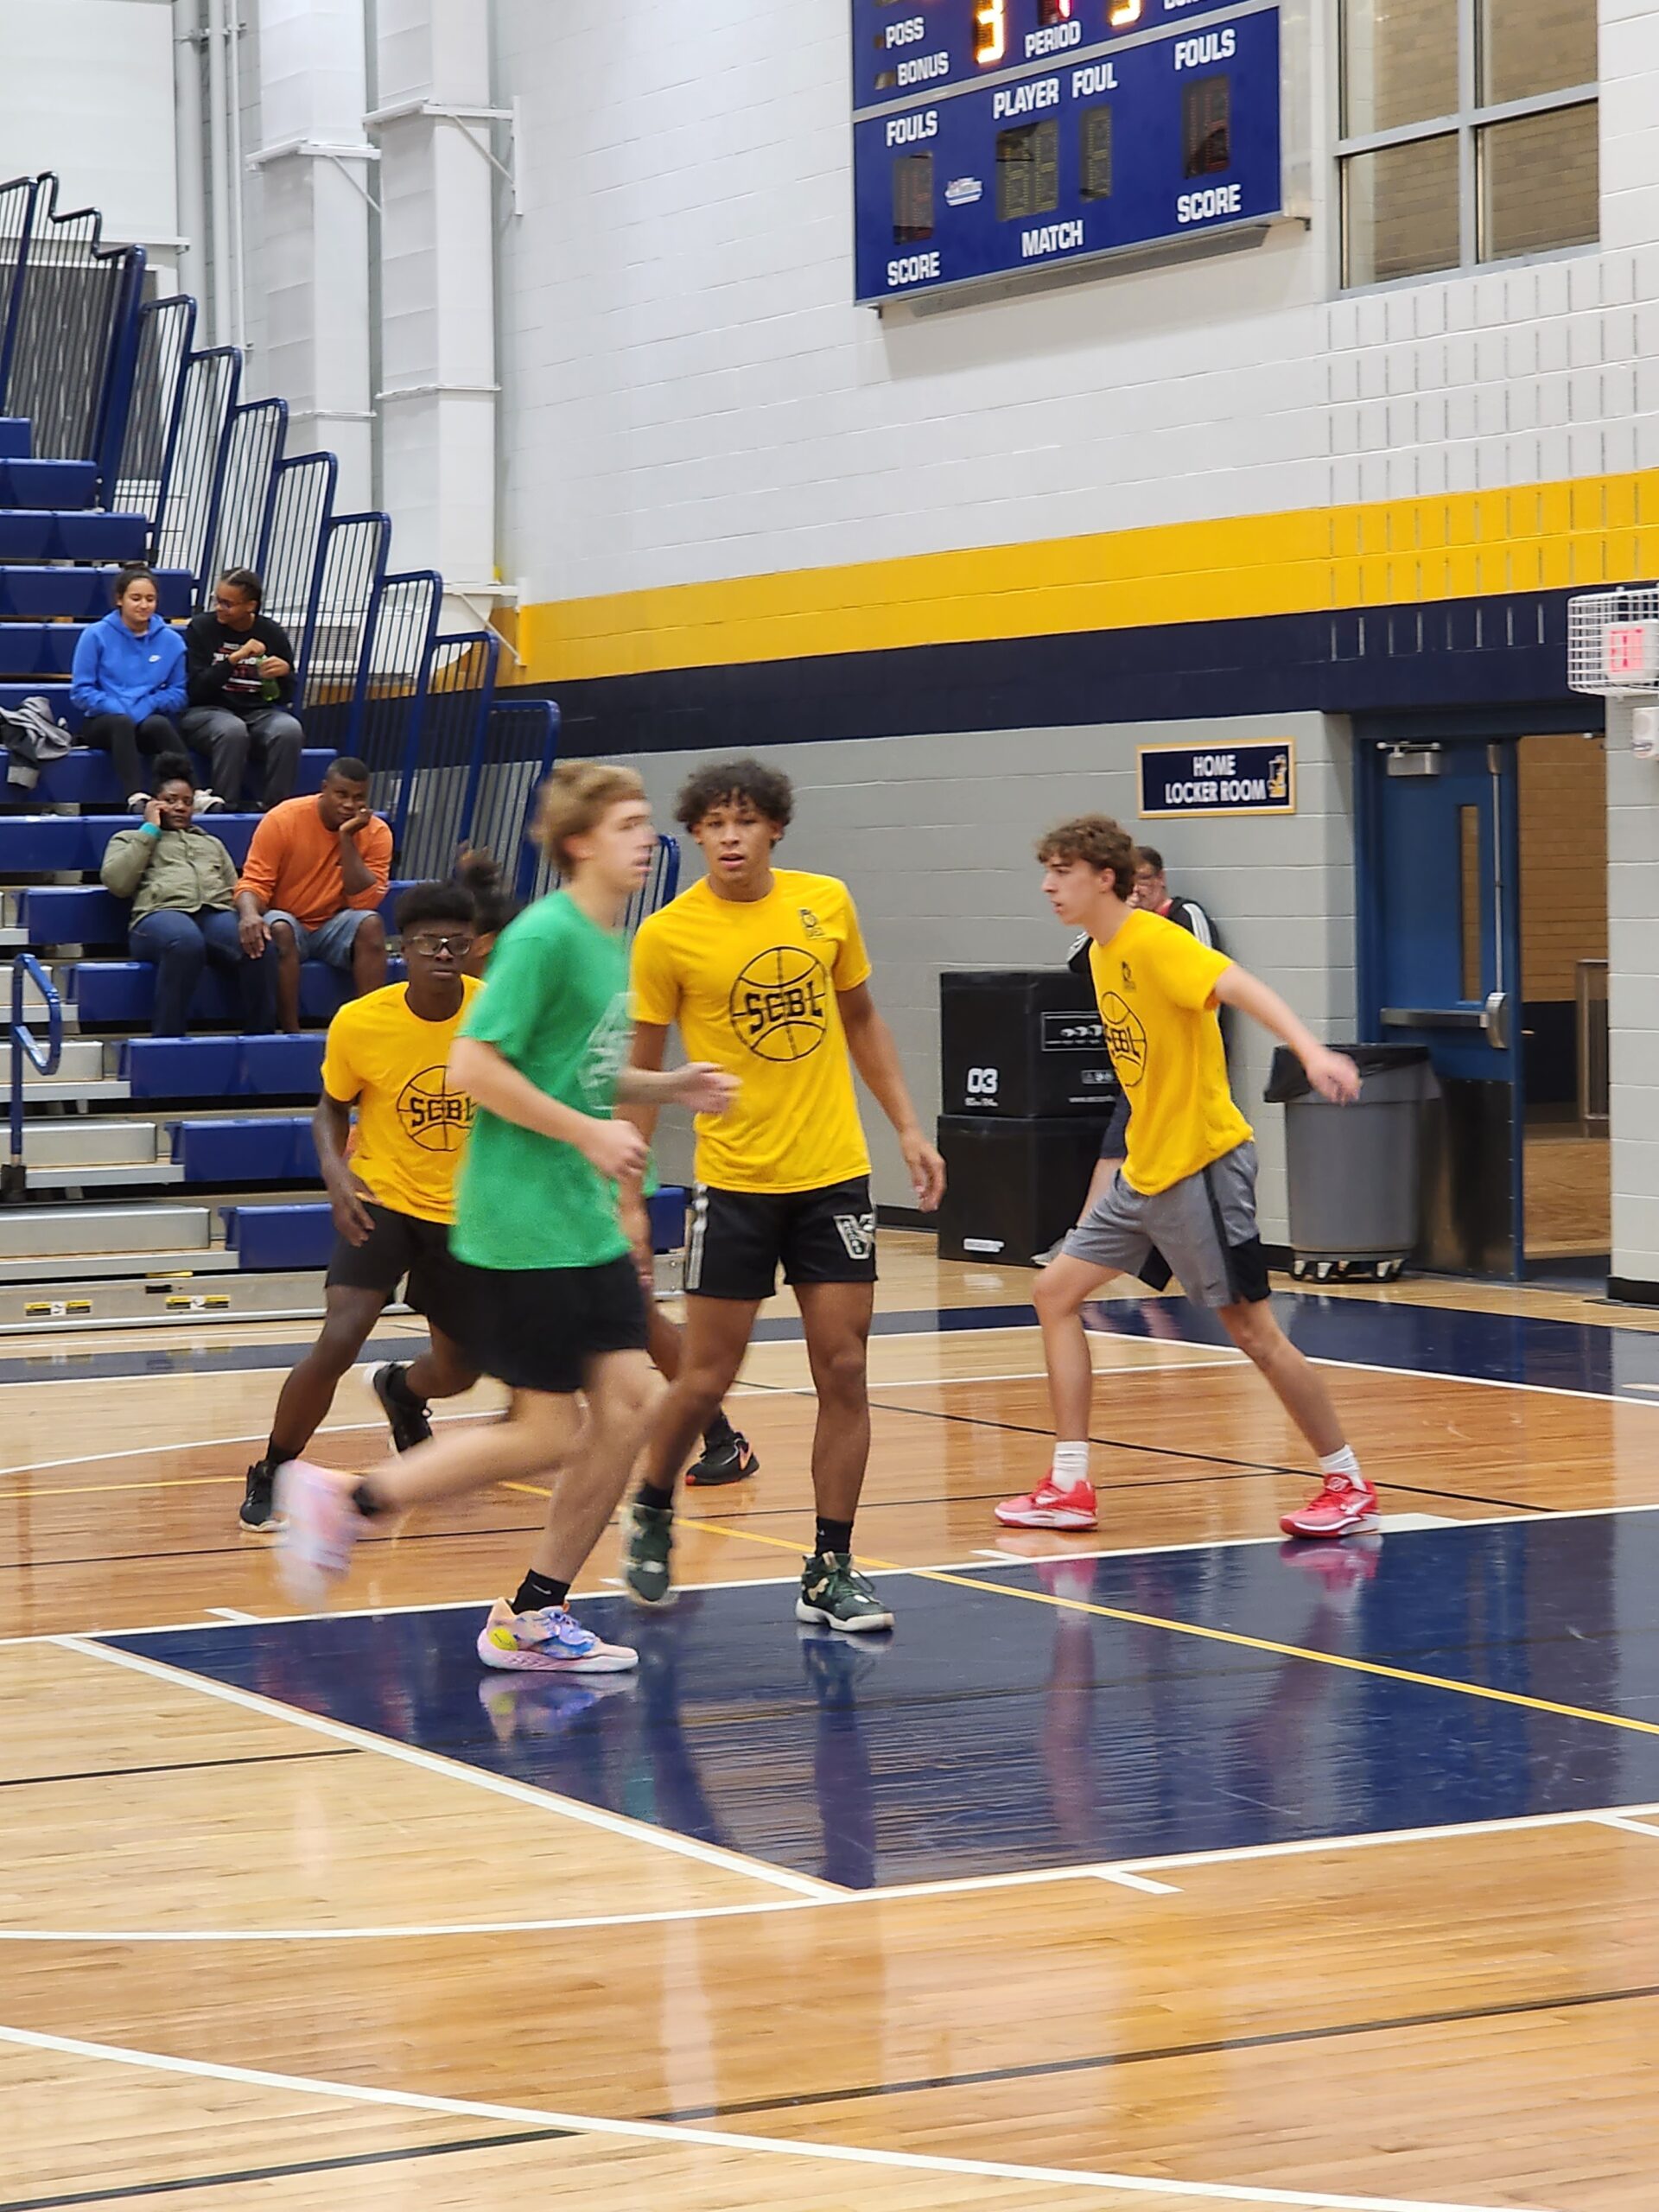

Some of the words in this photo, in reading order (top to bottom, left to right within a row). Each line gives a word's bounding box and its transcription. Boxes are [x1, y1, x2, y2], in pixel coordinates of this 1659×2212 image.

[885, 16, 925, 49] POSS
[1025, 20, 1081, 59] PERIOD
[1174, 28, 1236, 71] FOULS
[897, 51, 950, 86] BONUS
[993, 77, 1059, 119] PLAYER
[1071, 62, 1118, 99] FOUL
[886, 110, 938, 147] FOULS
[1177, 184, 1242, 224] SCORE
[1021, 219, 1084, 258] MATCH
[887, 251, 940, 287] SCORE
[1192, 754, 1236, 777] HOME
[1165, 781, 1218, 804] LOCKER
[1220, 779, 1267, 801] ROOM
[744, 981, 823, 1034] SEBL
[968, 1068, 998, 1094] 03
